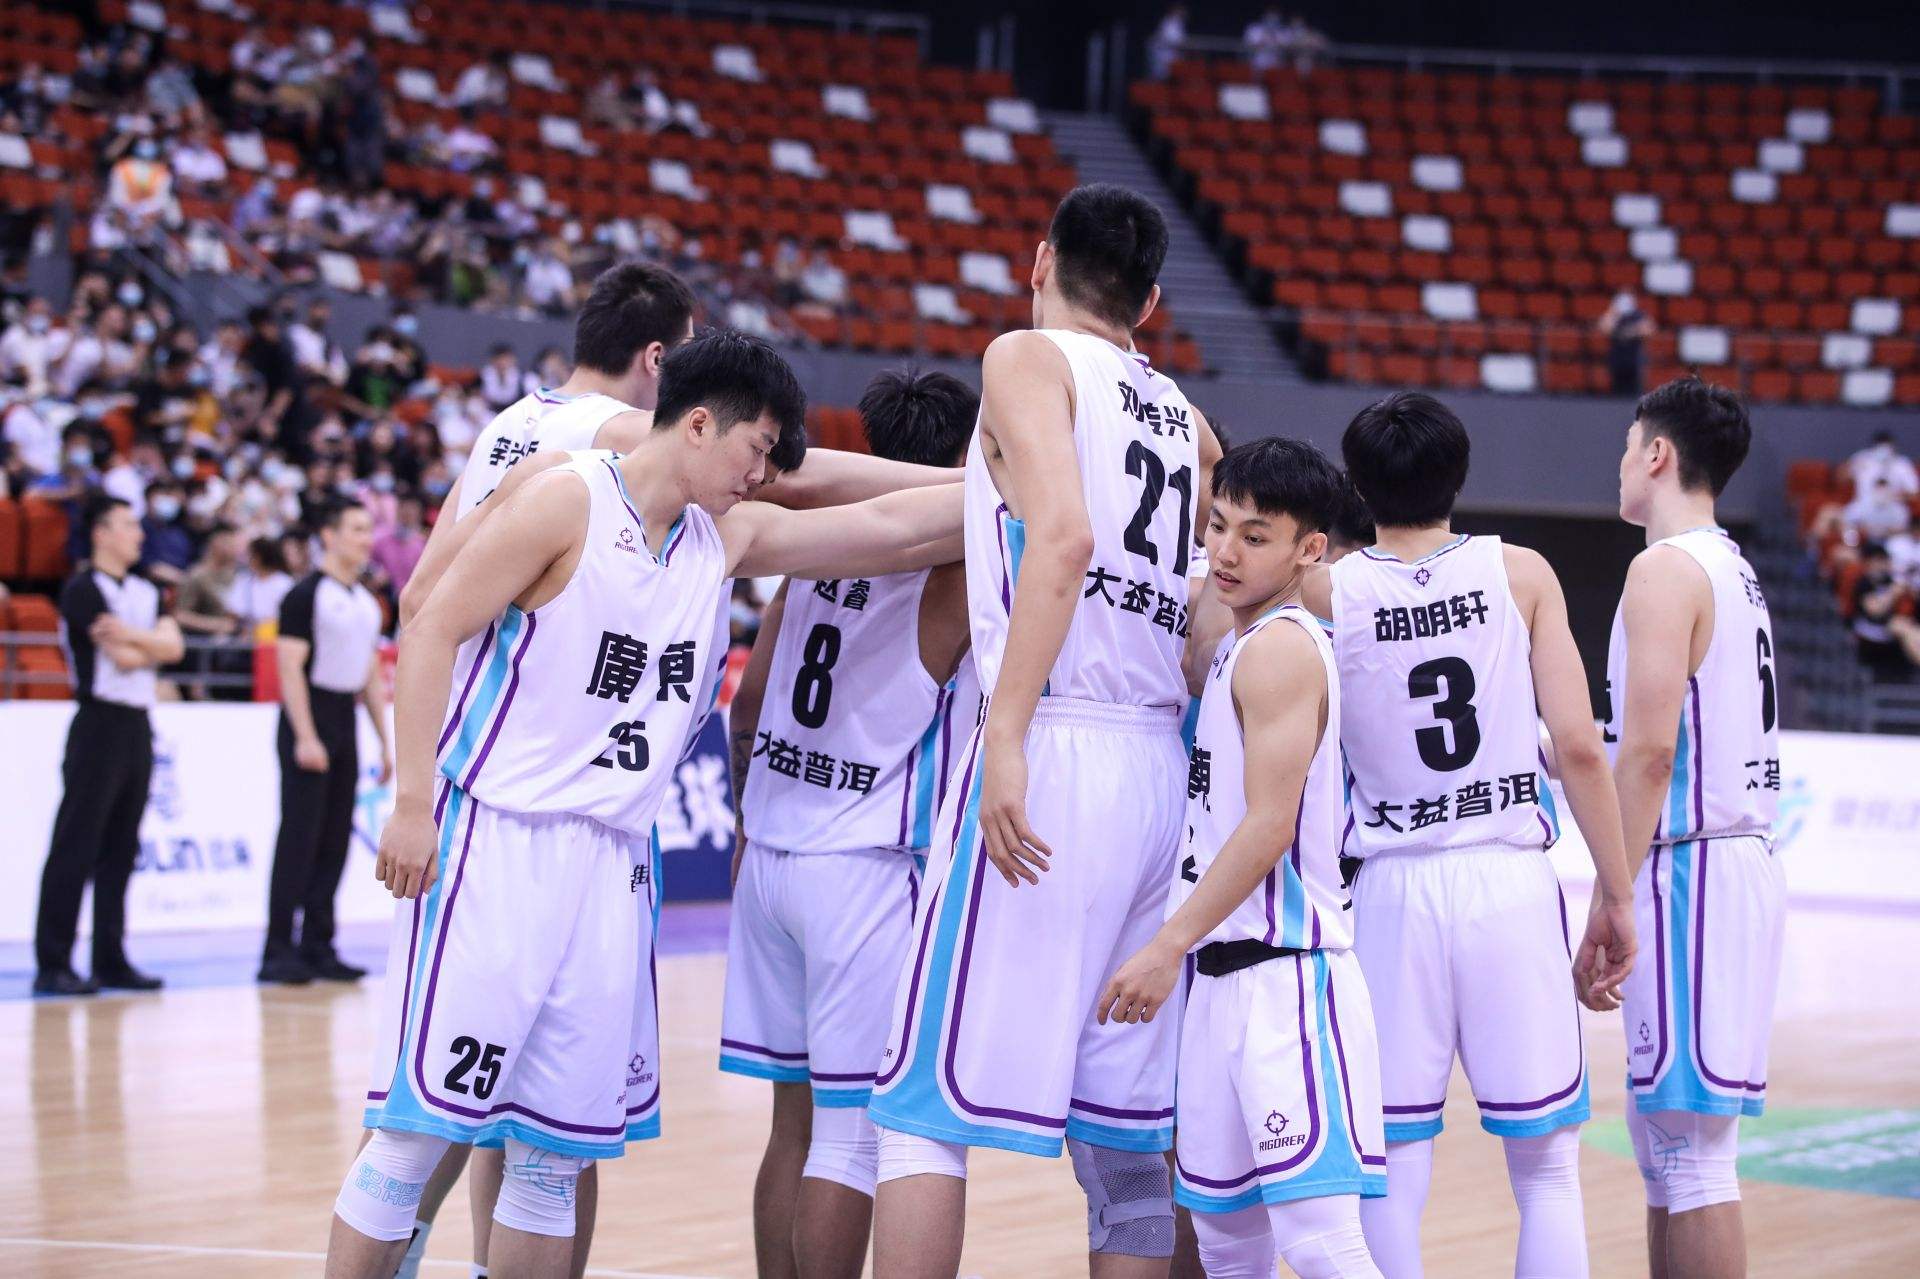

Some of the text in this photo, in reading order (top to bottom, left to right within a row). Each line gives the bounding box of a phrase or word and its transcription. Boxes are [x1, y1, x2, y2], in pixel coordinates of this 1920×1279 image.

[1123, 440, 1192, 580] 21
[614, 541, 640, 554] RIGORE
[1373, 590, 1489, 642] 胡明轩
[791, 623, 842, 729] 8
[590, 720, 650, 772] 25
[1408, 656, 1481, 772] 3
[752, 730, 880, 796] 大益普洱
[1364, 772, 1539, 834] 大益普洱
[444, 1035, 507, 1101] 25
[1258, 1133, 1306, 1152] RIGORER
